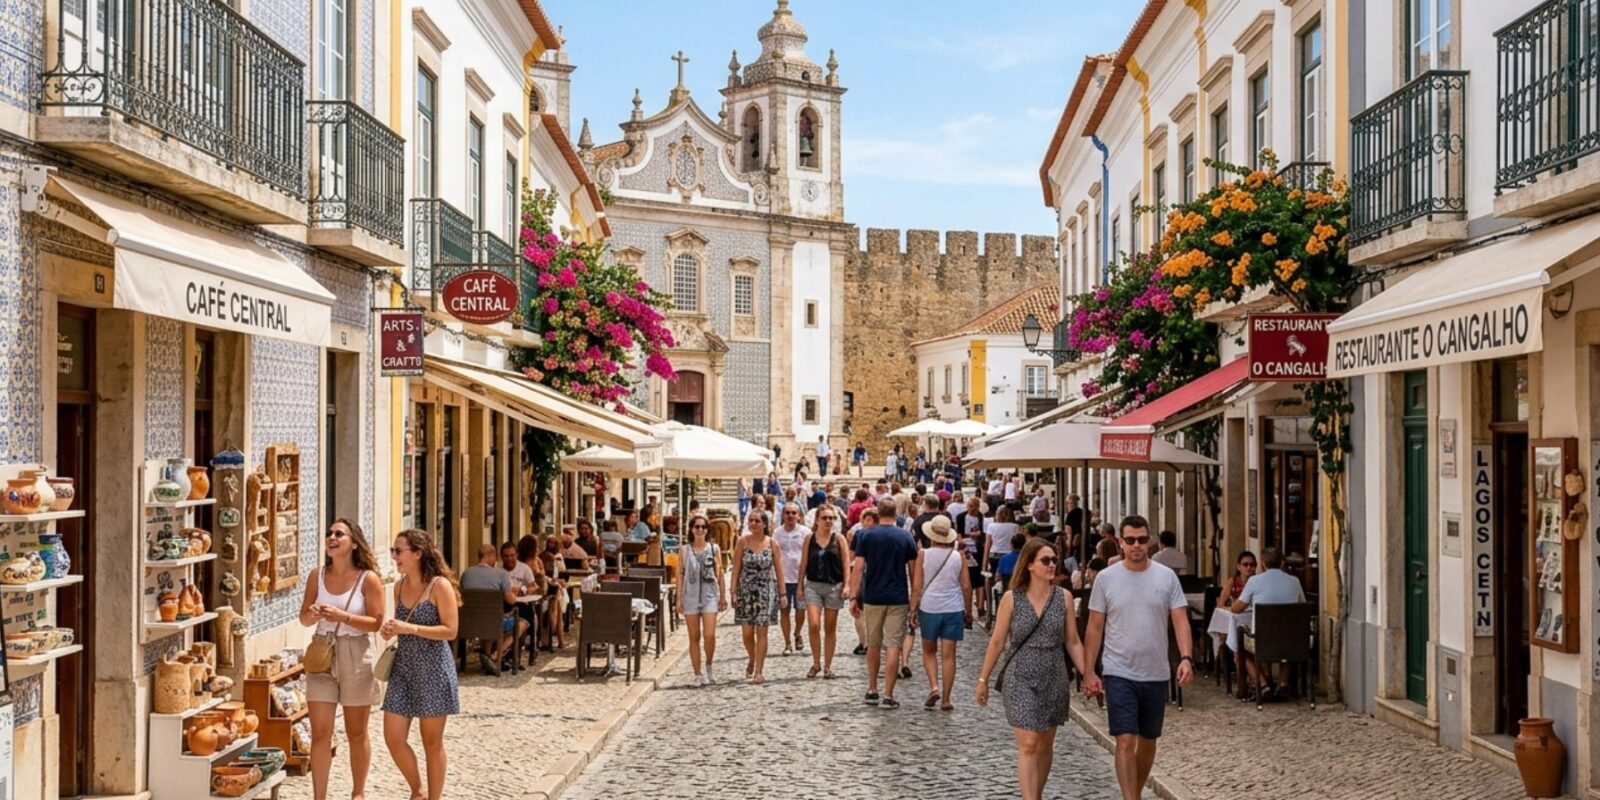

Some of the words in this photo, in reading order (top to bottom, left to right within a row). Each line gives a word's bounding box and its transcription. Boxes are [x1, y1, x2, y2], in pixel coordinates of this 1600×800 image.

[463, 275, 497, 293] CAFÉ
[186, 281, 226, 320] CAFÉ
[230, 292, 291, 333] CENTRAL
[451, 297, 510, 311] CENTRAL
[1254, 319, 1332, 331] RESTAURANT
[1335, 326, 1419, 371] RESTAURANTE
[1422, 324, 1434, 358] O
[1437, 304, 1529, 356] CANGALHO
[1252, 361, 1263, 375] O
[1475, 450, 1491, 543] LAGOS
[1477, 553, 1491, 627] CETN
